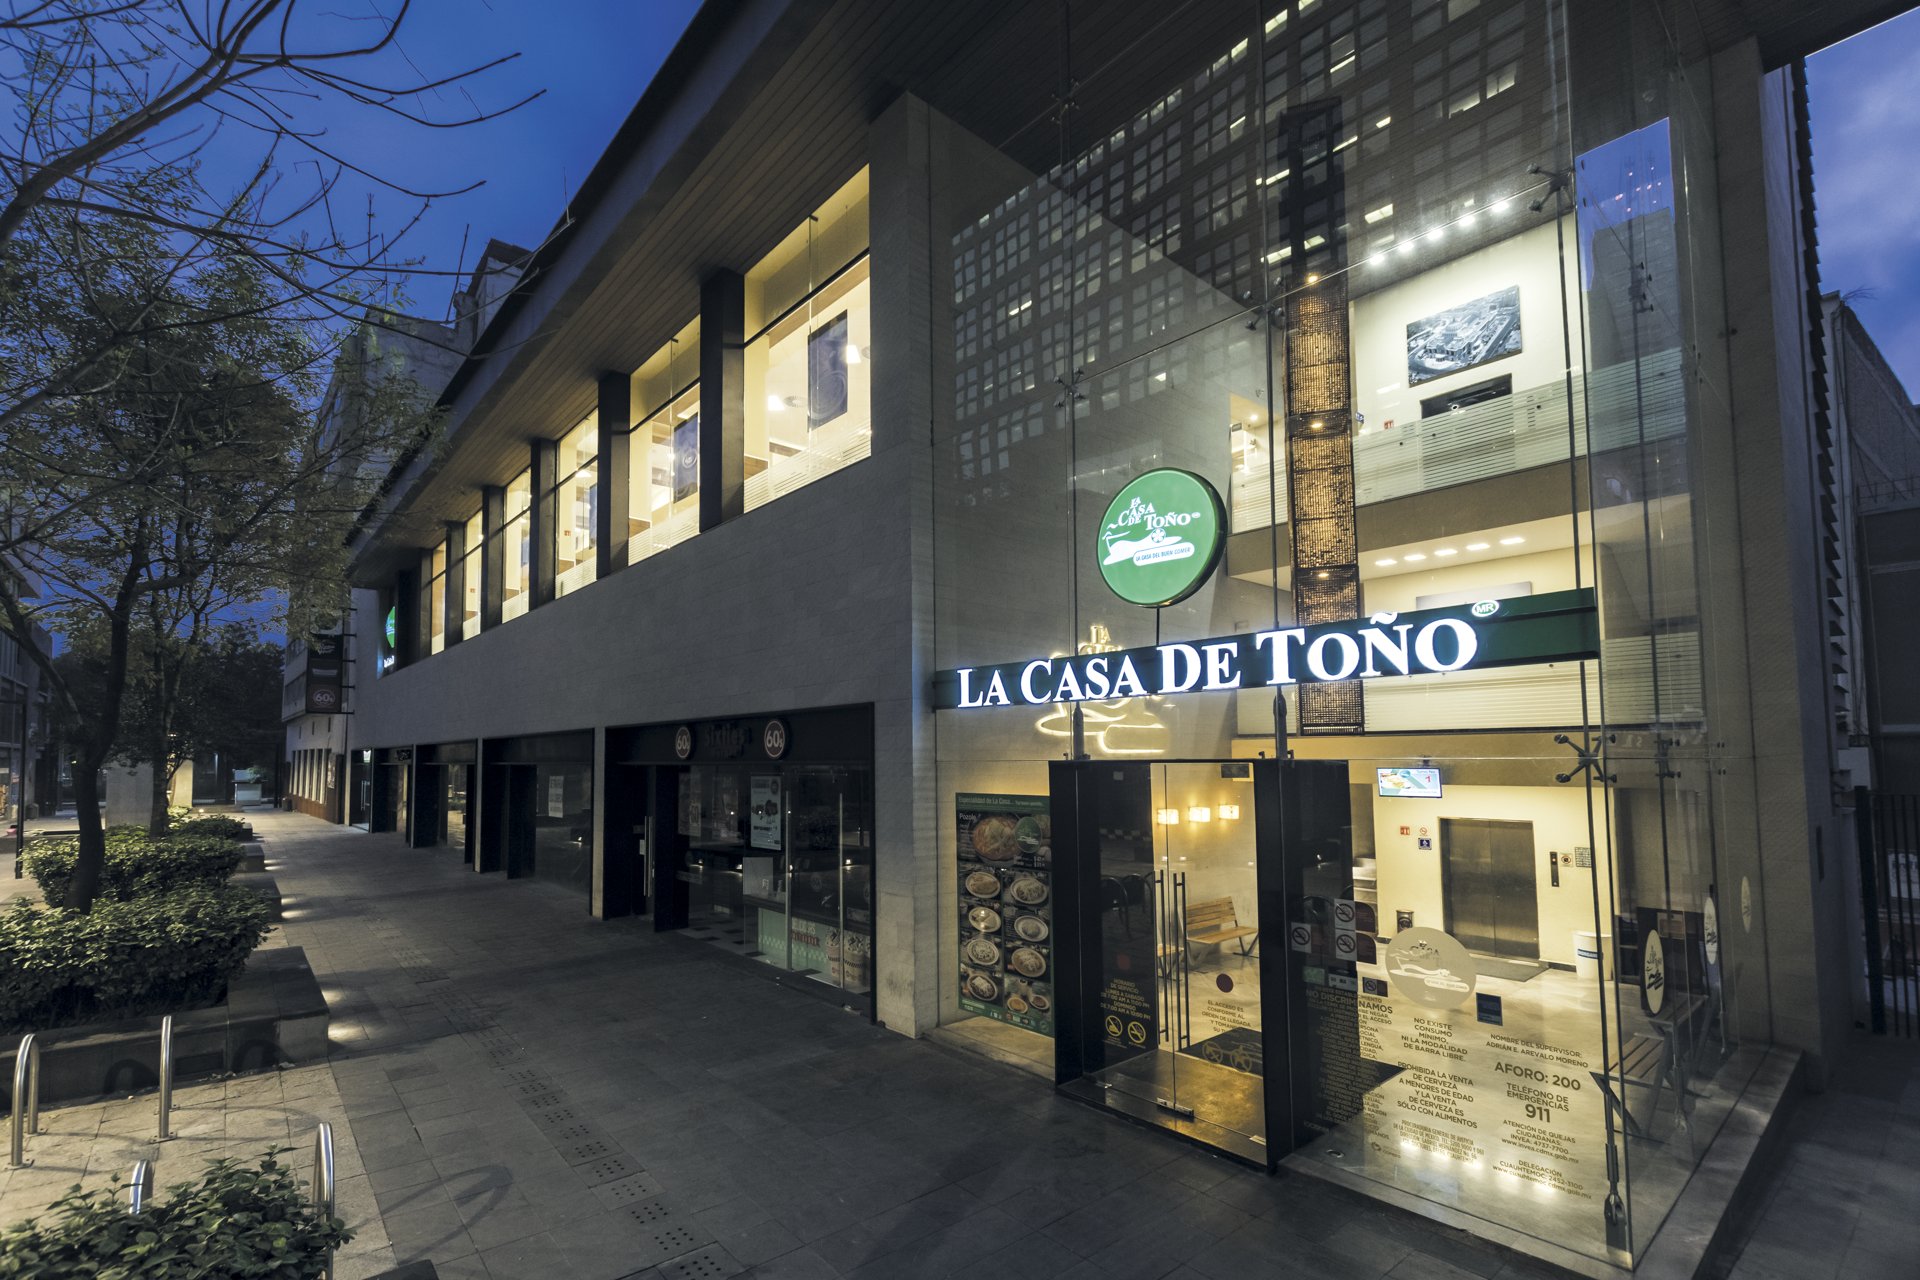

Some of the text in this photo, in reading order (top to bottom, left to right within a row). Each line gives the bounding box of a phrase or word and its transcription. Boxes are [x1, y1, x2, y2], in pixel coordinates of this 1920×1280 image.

[1118, 502, 1155, 526] CASA
[1128, 515, 1141, 526] DE
[1144, 512, 1191, 530] TOÑO
[957, 604, 1494, 708] LA CASA DE TOÑO MR
[1208, 1006, 1236, 1017] CONFORME
[1216, 1001, 1236, 1011] ACCESO
[1202, 1011, 1218, 1019] ORDEN
[1227, 1018, 1251, 1027] LLEGADA
[1370, 1016, 1392, 1024] ACCESO
[1427, 1020, 1452, 1030] EXISTE
[1414, 1025, 1452, 1037] CONSUMO
[1415, 1045, 1440, 1055] BARRA
[1442, 1052, 1466, 1062] LIBRE.
[1422, 1040, 1467, 1054] MODALIDAD
[1486, 1041, 1512, 1051] ADRIÁN
[1556, 1056, 1588, 1068] MORENO
[1490, 1034, 1582, 1058] NOMBRE DEL SUPERVISOR:
[1398, 1062, 1474, 1086] PROHIBIDA LA VENTA
[1413, 1073, 1458, 1090] DE CERVEZA
[1495, 1062, 1580, 1090] AFORO: 200
[1406, 1079, 1440, 1093] MENORES
[1453, 1091, 1474, 1102] EDAD
[1507, 1082, 1568, 1104] TELÉFONO DE
[1409, 1096, 1418, 1104] DE
[1420, 1099, 1453, 1113] CERVEZA
[1432, 1094, 1457, 1106] VENTA
[1507, 1090, 1569, 1112] EMERGENCIAS
[1397, 1100, 1477, 1128] SÓLO CON ALIMENTOS
[1525, 1104, 1550, 1123] 911
[1503, 1120, 1536, 1132] ATENCIÓN
[1549, 1131, 1576, 1144] QUEJAS
[1516, 1130, 1562, 1146] CIUDADANAS:
[1511, 1134, 1569, 1155] INVEA: 4737-7700
[1519, 1160, 1562, 1177] DELEGACIÓN
